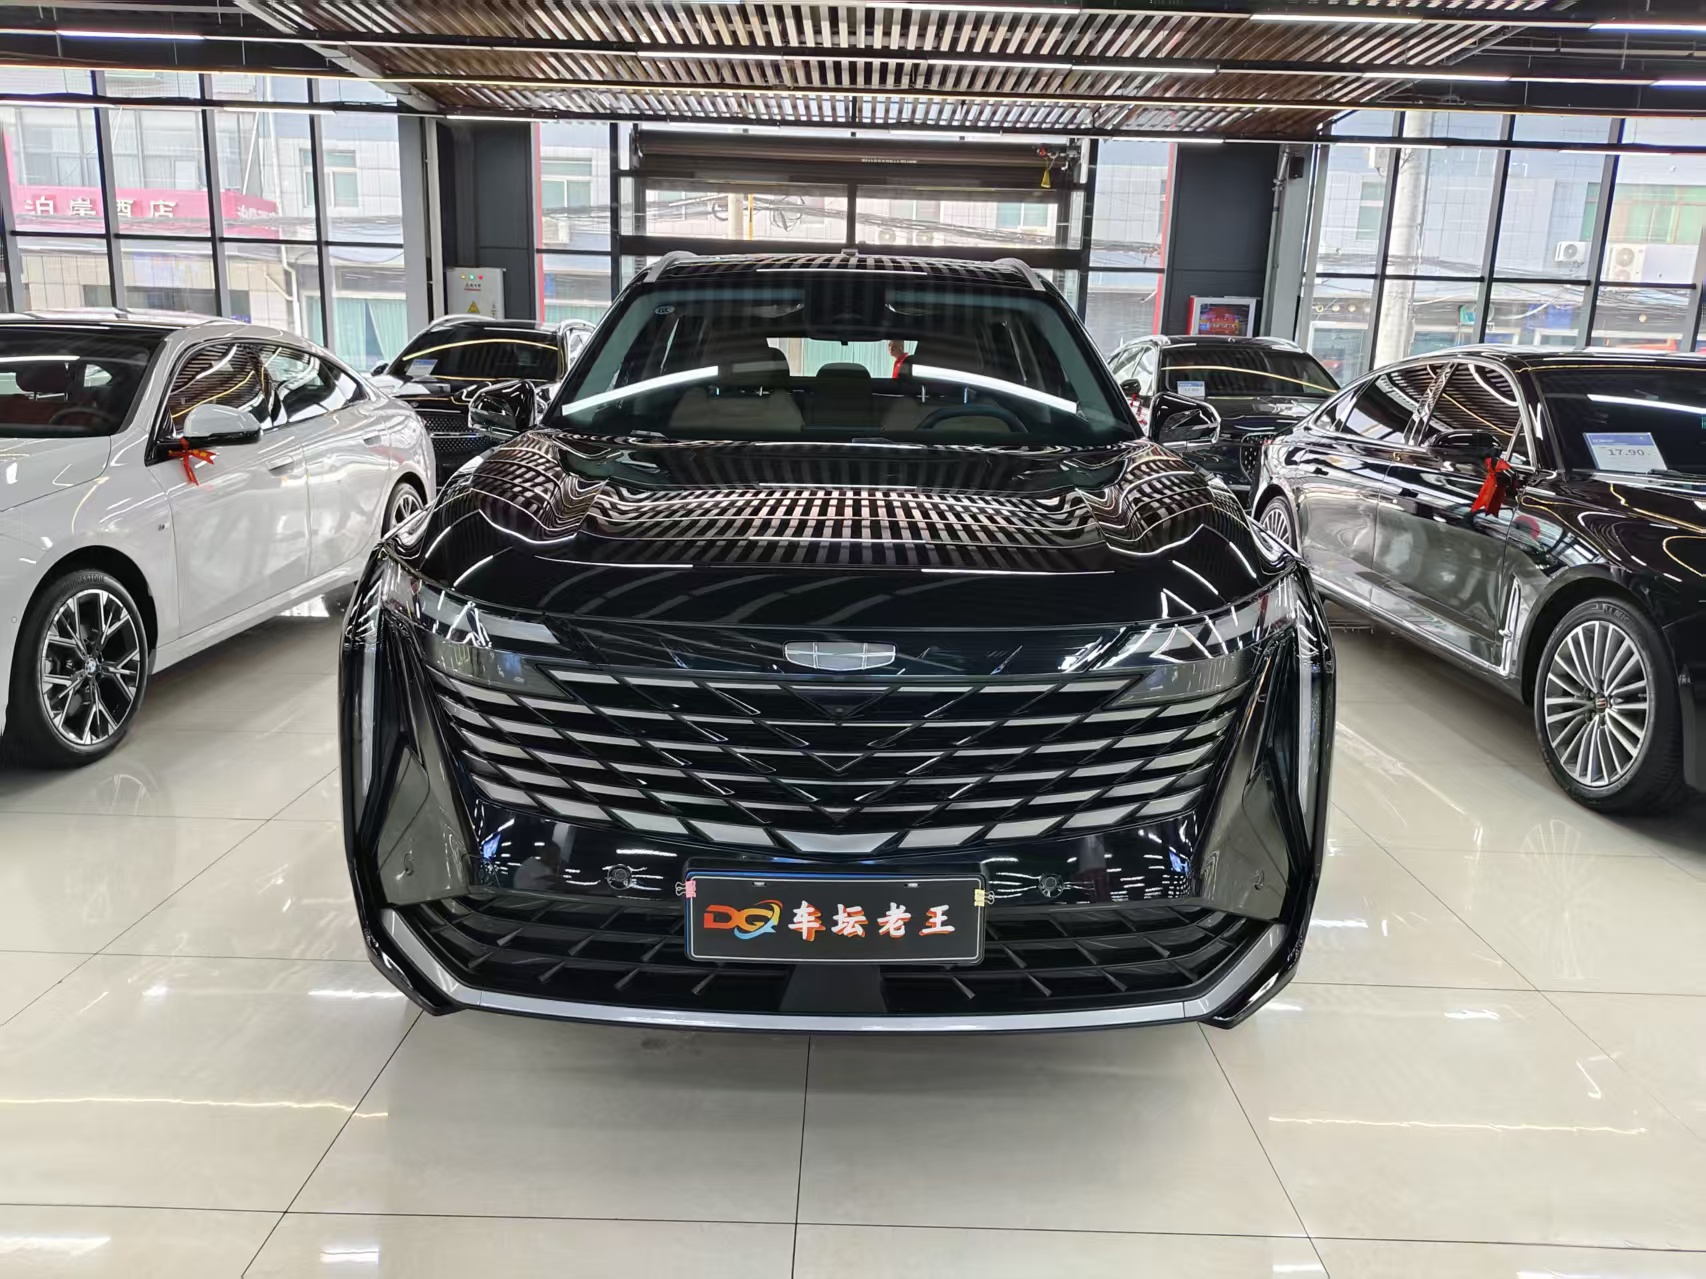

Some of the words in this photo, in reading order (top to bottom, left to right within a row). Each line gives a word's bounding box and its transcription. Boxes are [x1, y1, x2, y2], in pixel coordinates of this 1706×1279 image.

[1608, 448, 1645, 456] 17.90
[788, 900, 956, 942] 车坛老王
